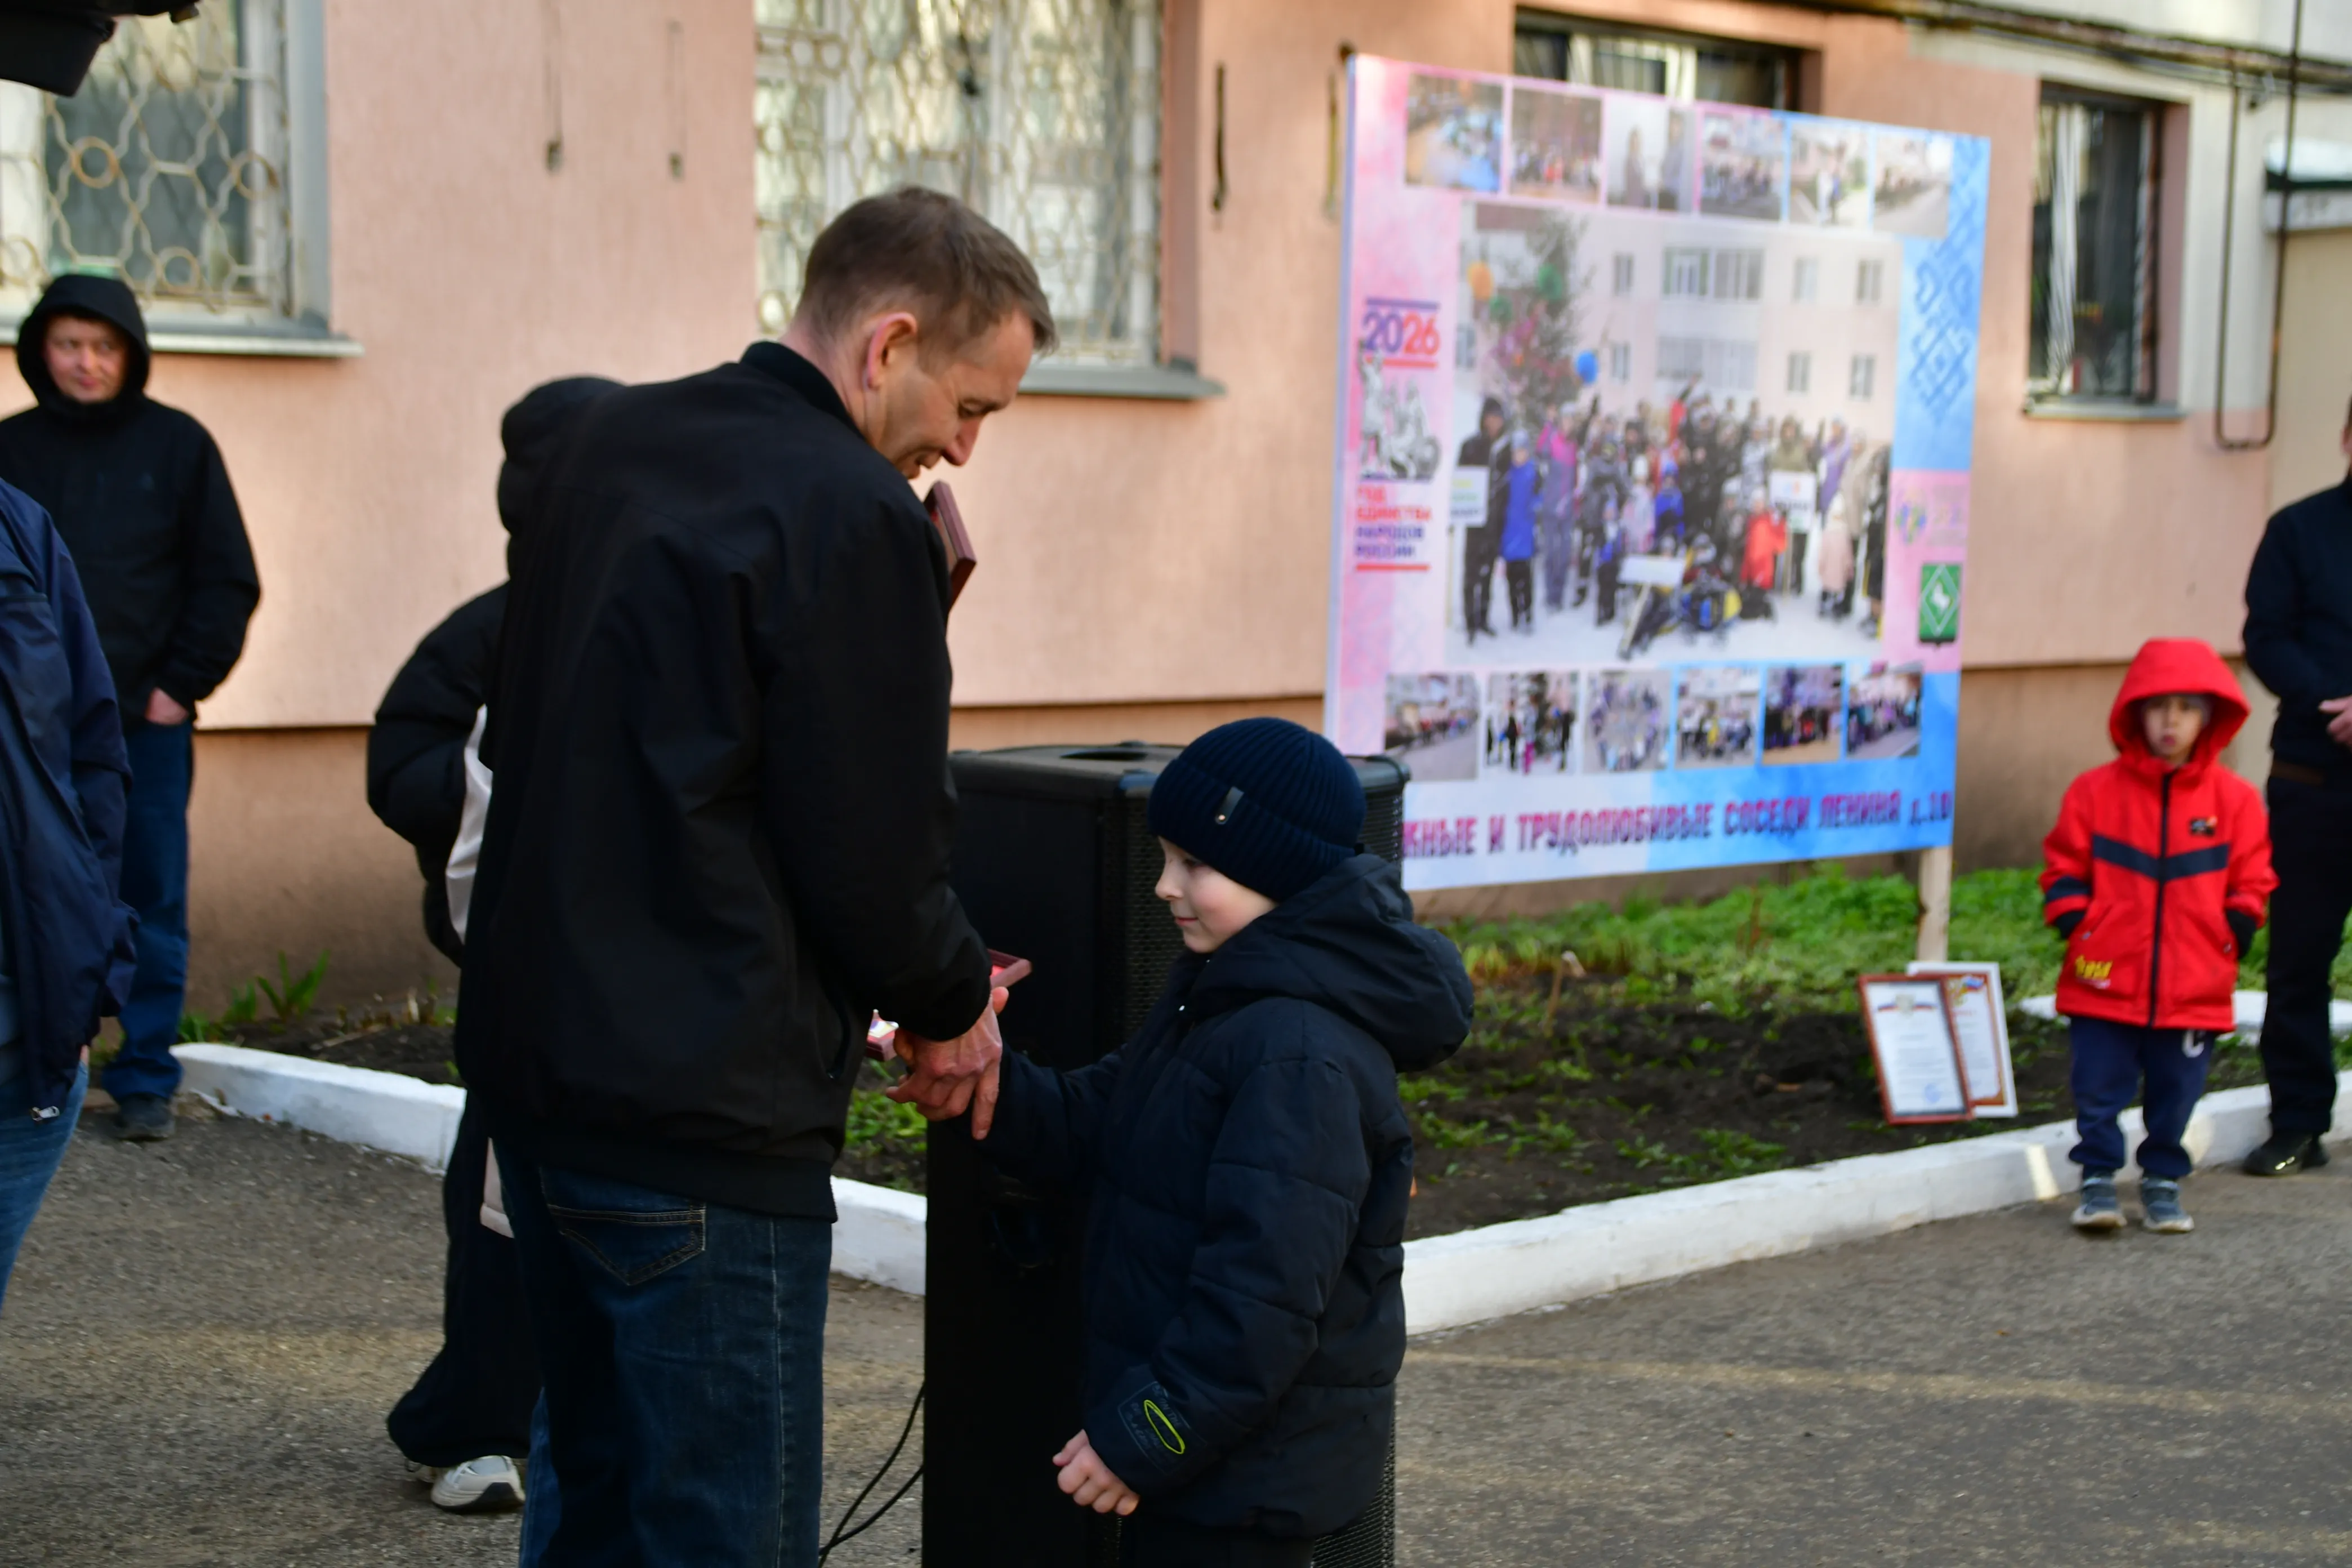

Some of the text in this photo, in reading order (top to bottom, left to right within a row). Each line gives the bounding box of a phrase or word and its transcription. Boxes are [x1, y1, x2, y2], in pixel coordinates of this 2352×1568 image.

[1363, 311, 1440, 355] 2026
[1488, 814, 1505, 854] И
[1516, 803, 1714, 857] ТРУДОЛЮБИВЫЕ
[1723, 795, 1811, 838] СОСЕДИ
[1819, 789, 1902, 828] ЛЕНИНА
